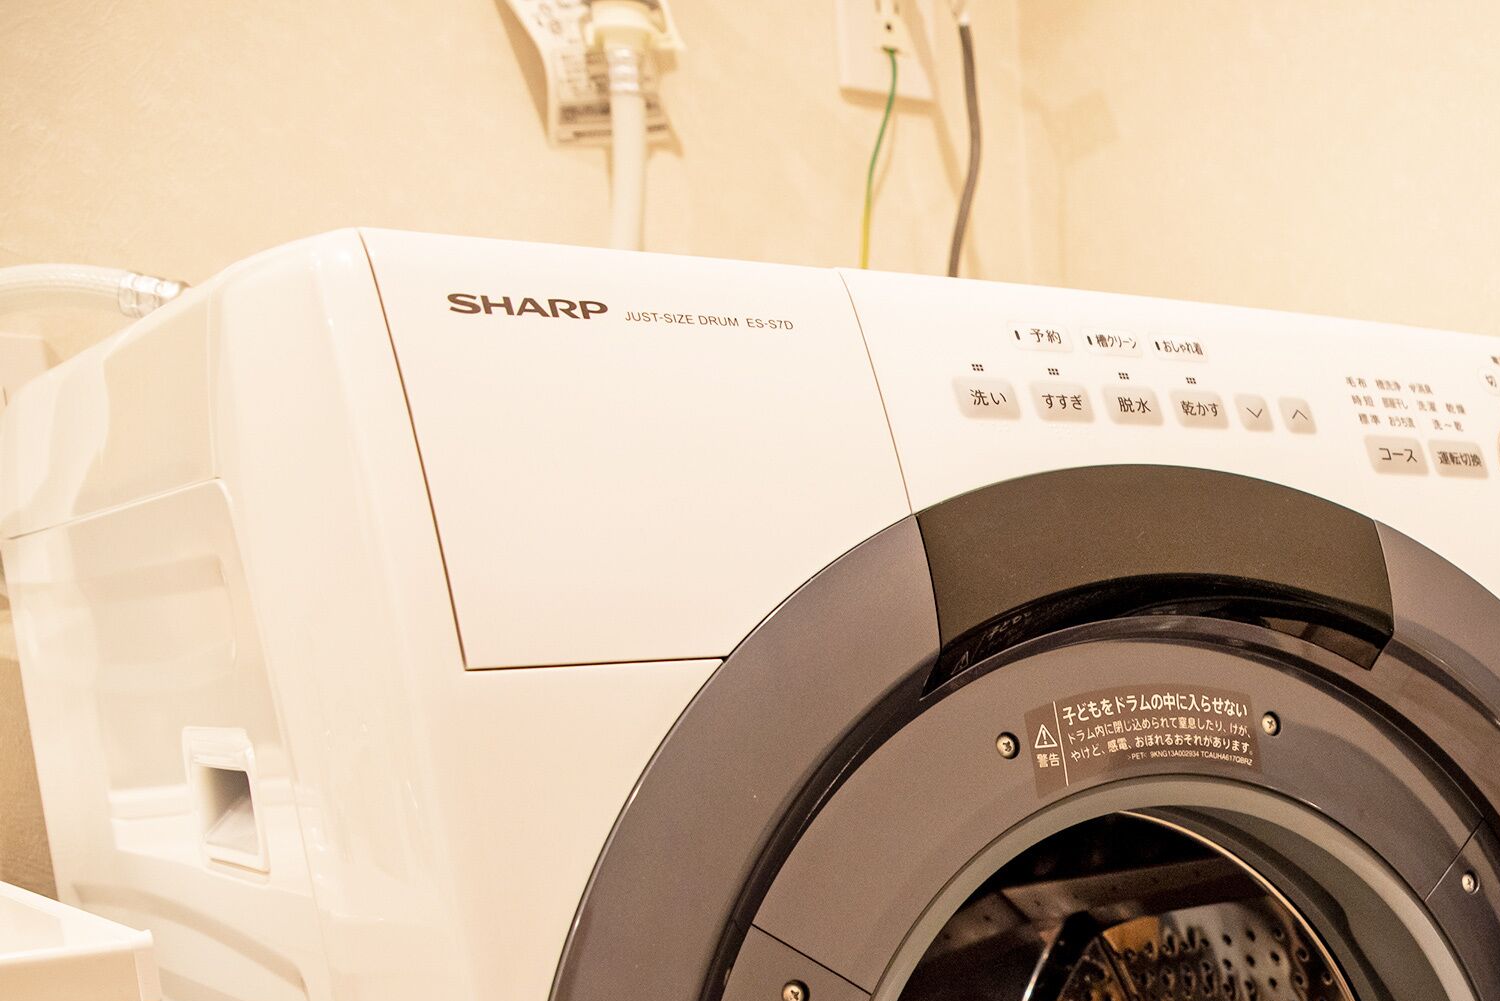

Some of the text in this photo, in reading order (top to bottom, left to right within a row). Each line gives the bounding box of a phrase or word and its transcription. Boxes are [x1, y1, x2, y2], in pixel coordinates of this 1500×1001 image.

[447, 293, 608, 320] SHARP
[624, 311, 794, 331] JUST-SIZE DRUM ES-S7D
[1029, 328, 1062, 345] 予約
[1095, 333, 1137, 350] 槽クリーン
[1162, 340, 1204, 356] おしゃれ着
[1346, 376, 1368, 388] 毛布
[969, 388, 1007, 407] 洗い
[1042, 393, 1084, 411] すすぎ
[1117, 396, 1152, 414] 脱水
[1180, 400, 1219, 417] 乾かす
[1358, 413, 1381, 425] 標準
[1378, 446, 1418, 464] コース
[1436, 450, 1482, 468] 運転切換
[1062, 692, 1248, 726] 子どもをドラムの中に入らせない
[1067, 716, 1251, 745] ドラム内に閉じ込められて窒息したり、けが、
[1070, 733, 1254, 763] やけど、感電、おぼれるおそれがあります。
[1036, 753, 1060, 768] 警告
